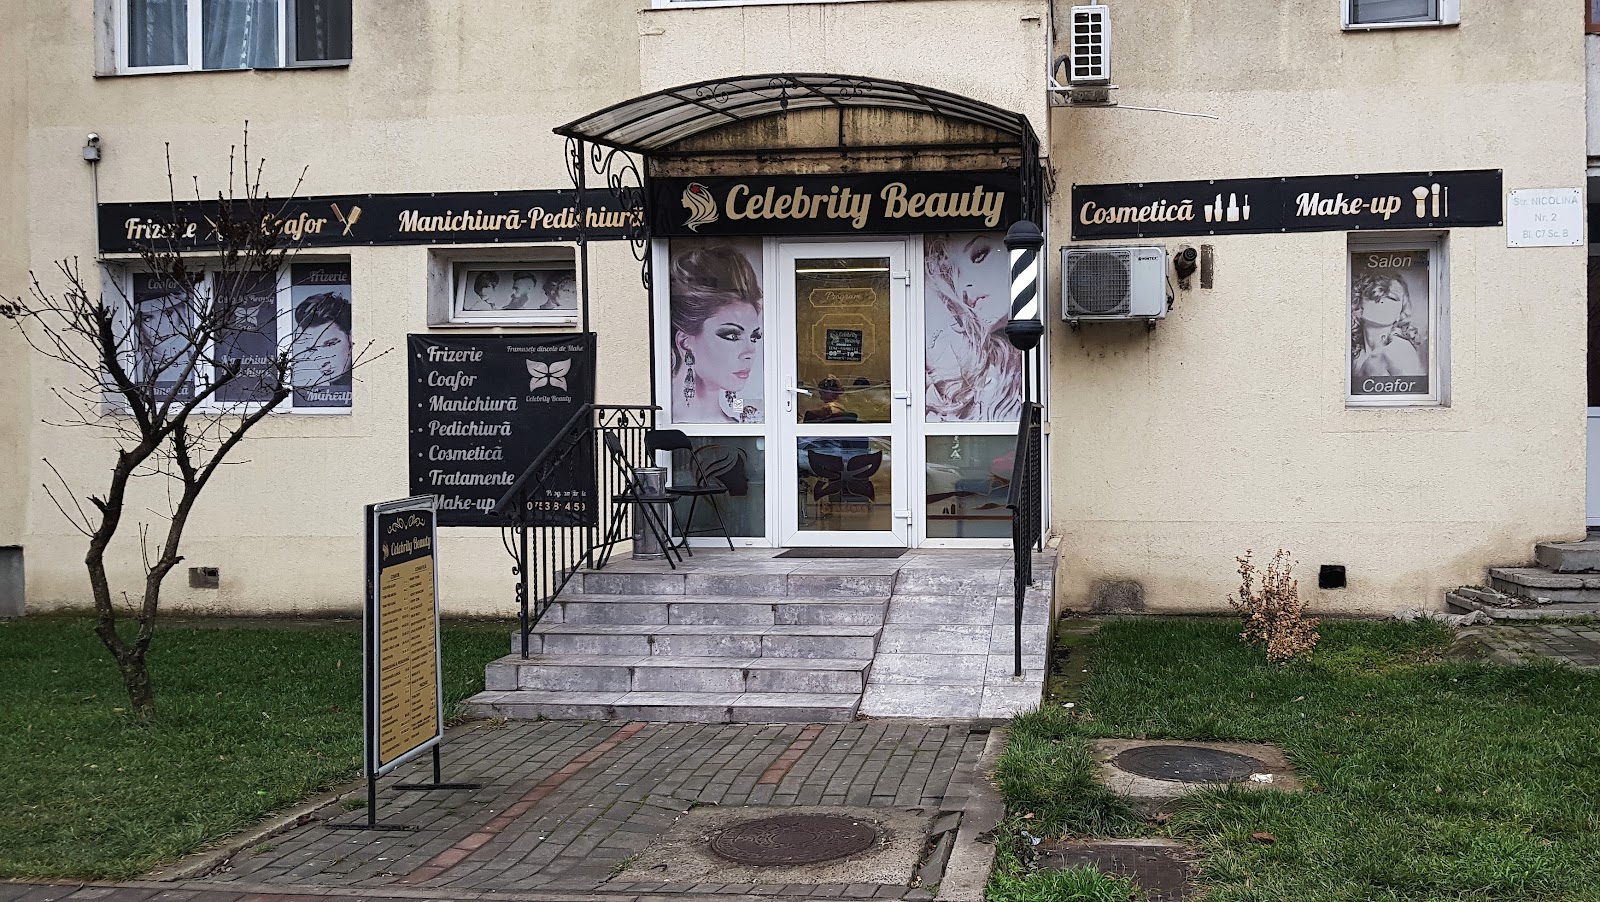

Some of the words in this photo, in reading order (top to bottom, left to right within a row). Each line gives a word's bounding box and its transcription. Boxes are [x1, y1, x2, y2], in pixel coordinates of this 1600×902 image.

[725, 183, 872, 229] Celebrity
[880, 181, 1006, 228] Beauty
[1295, 192, 1402, 221] Make-up
[1513, 197, 1529, 206] Str.
[1531, 196, 1579, 205] NICOLINA
[1534, 213, 1548, 222] Nr.
[1550, 212, 1557, 222] 2
[125, 217, 197, 239] Frize
[1535, 229, 1546, 238] C7
[1548, 229, 1560, 238] Sc.
[1562, 229, 1569, 238] B
[1367, 254, 1412, 268] Salon
[309, 270, 348, 283] Frizerie
[426, 345, 483, 363] Frizerie
[427, 370, 478, 392] Coafor
[1362, 378, 1417, 393] Coafor
[307, 388, 352, 405] Makeup
[526, 395, 550, 404] Celebrity
[551, 394, 572, 403] Beauty
[428, 469, 515, 486] Tratamente
[432, 494, 496, 515] Make-up
[391, 540, 413, 556] Celebrity
[413, 535, 432, 550] Beauty
